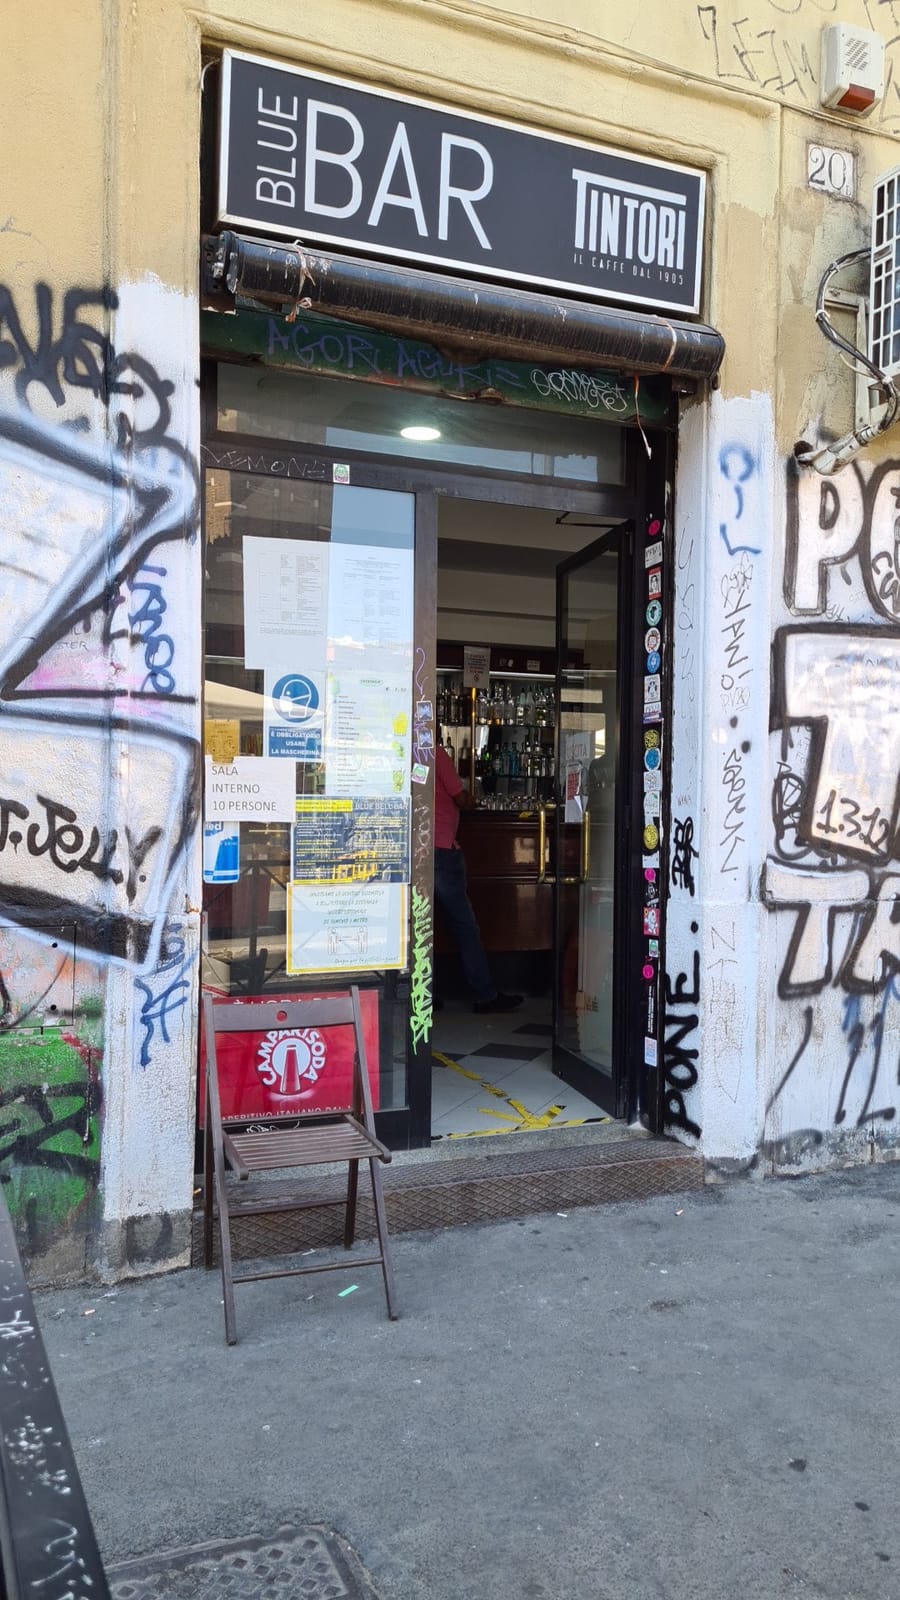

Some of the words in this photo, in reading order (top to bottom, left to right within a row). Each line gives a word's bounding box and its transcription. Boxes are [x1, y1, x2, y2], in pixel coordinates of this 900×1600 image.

[256, 88, 298, 208] BLUE
[304, 98, 493, 250] BAR
[809, 147, 847, 190] 20
[572, 168, 687, 270] TINTORI
[573, 253, 583, 265] IL
[633, 265, 651, 279] DAL
[659, 271, 684, 285] 1905
[276, 731, 320, 739] OBBLIGATORIO
[280, 748, 320, 756] MASCHERINA
[211, 765, 239, 777] SALA
[212, 783, 260, 794] INTERNO
[213, 801, 226, 811] 10
[228, 801, 277, 812] PERSONE
